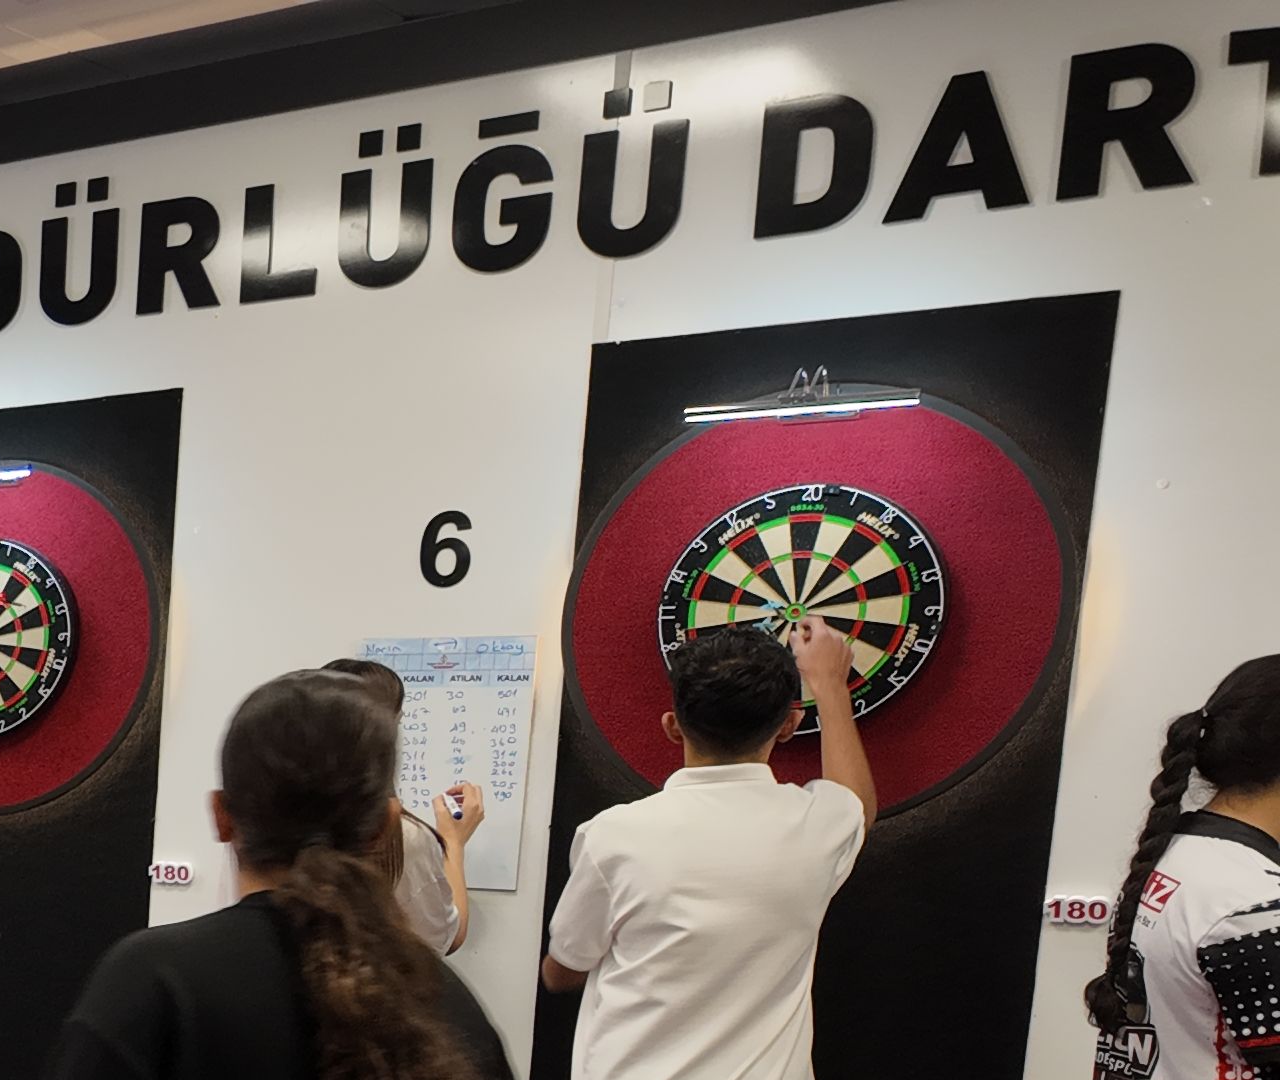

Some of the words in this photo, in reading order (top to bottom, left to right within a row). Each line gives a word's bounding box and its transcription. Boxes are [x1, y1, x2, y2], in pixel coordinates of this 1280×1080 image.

[802, 485, 824, 501] 20
[857, 512, 896, 538] HELIX
[420, 510, 472, 588] 6
[403, 675, 435, 683] KALAN
[450, 674, 483, 683] ATILAN
[497, 674, 530, 682] KALAN
[152, 865, 189, 881] 180
[1047, 900, 1108, 920] 180
